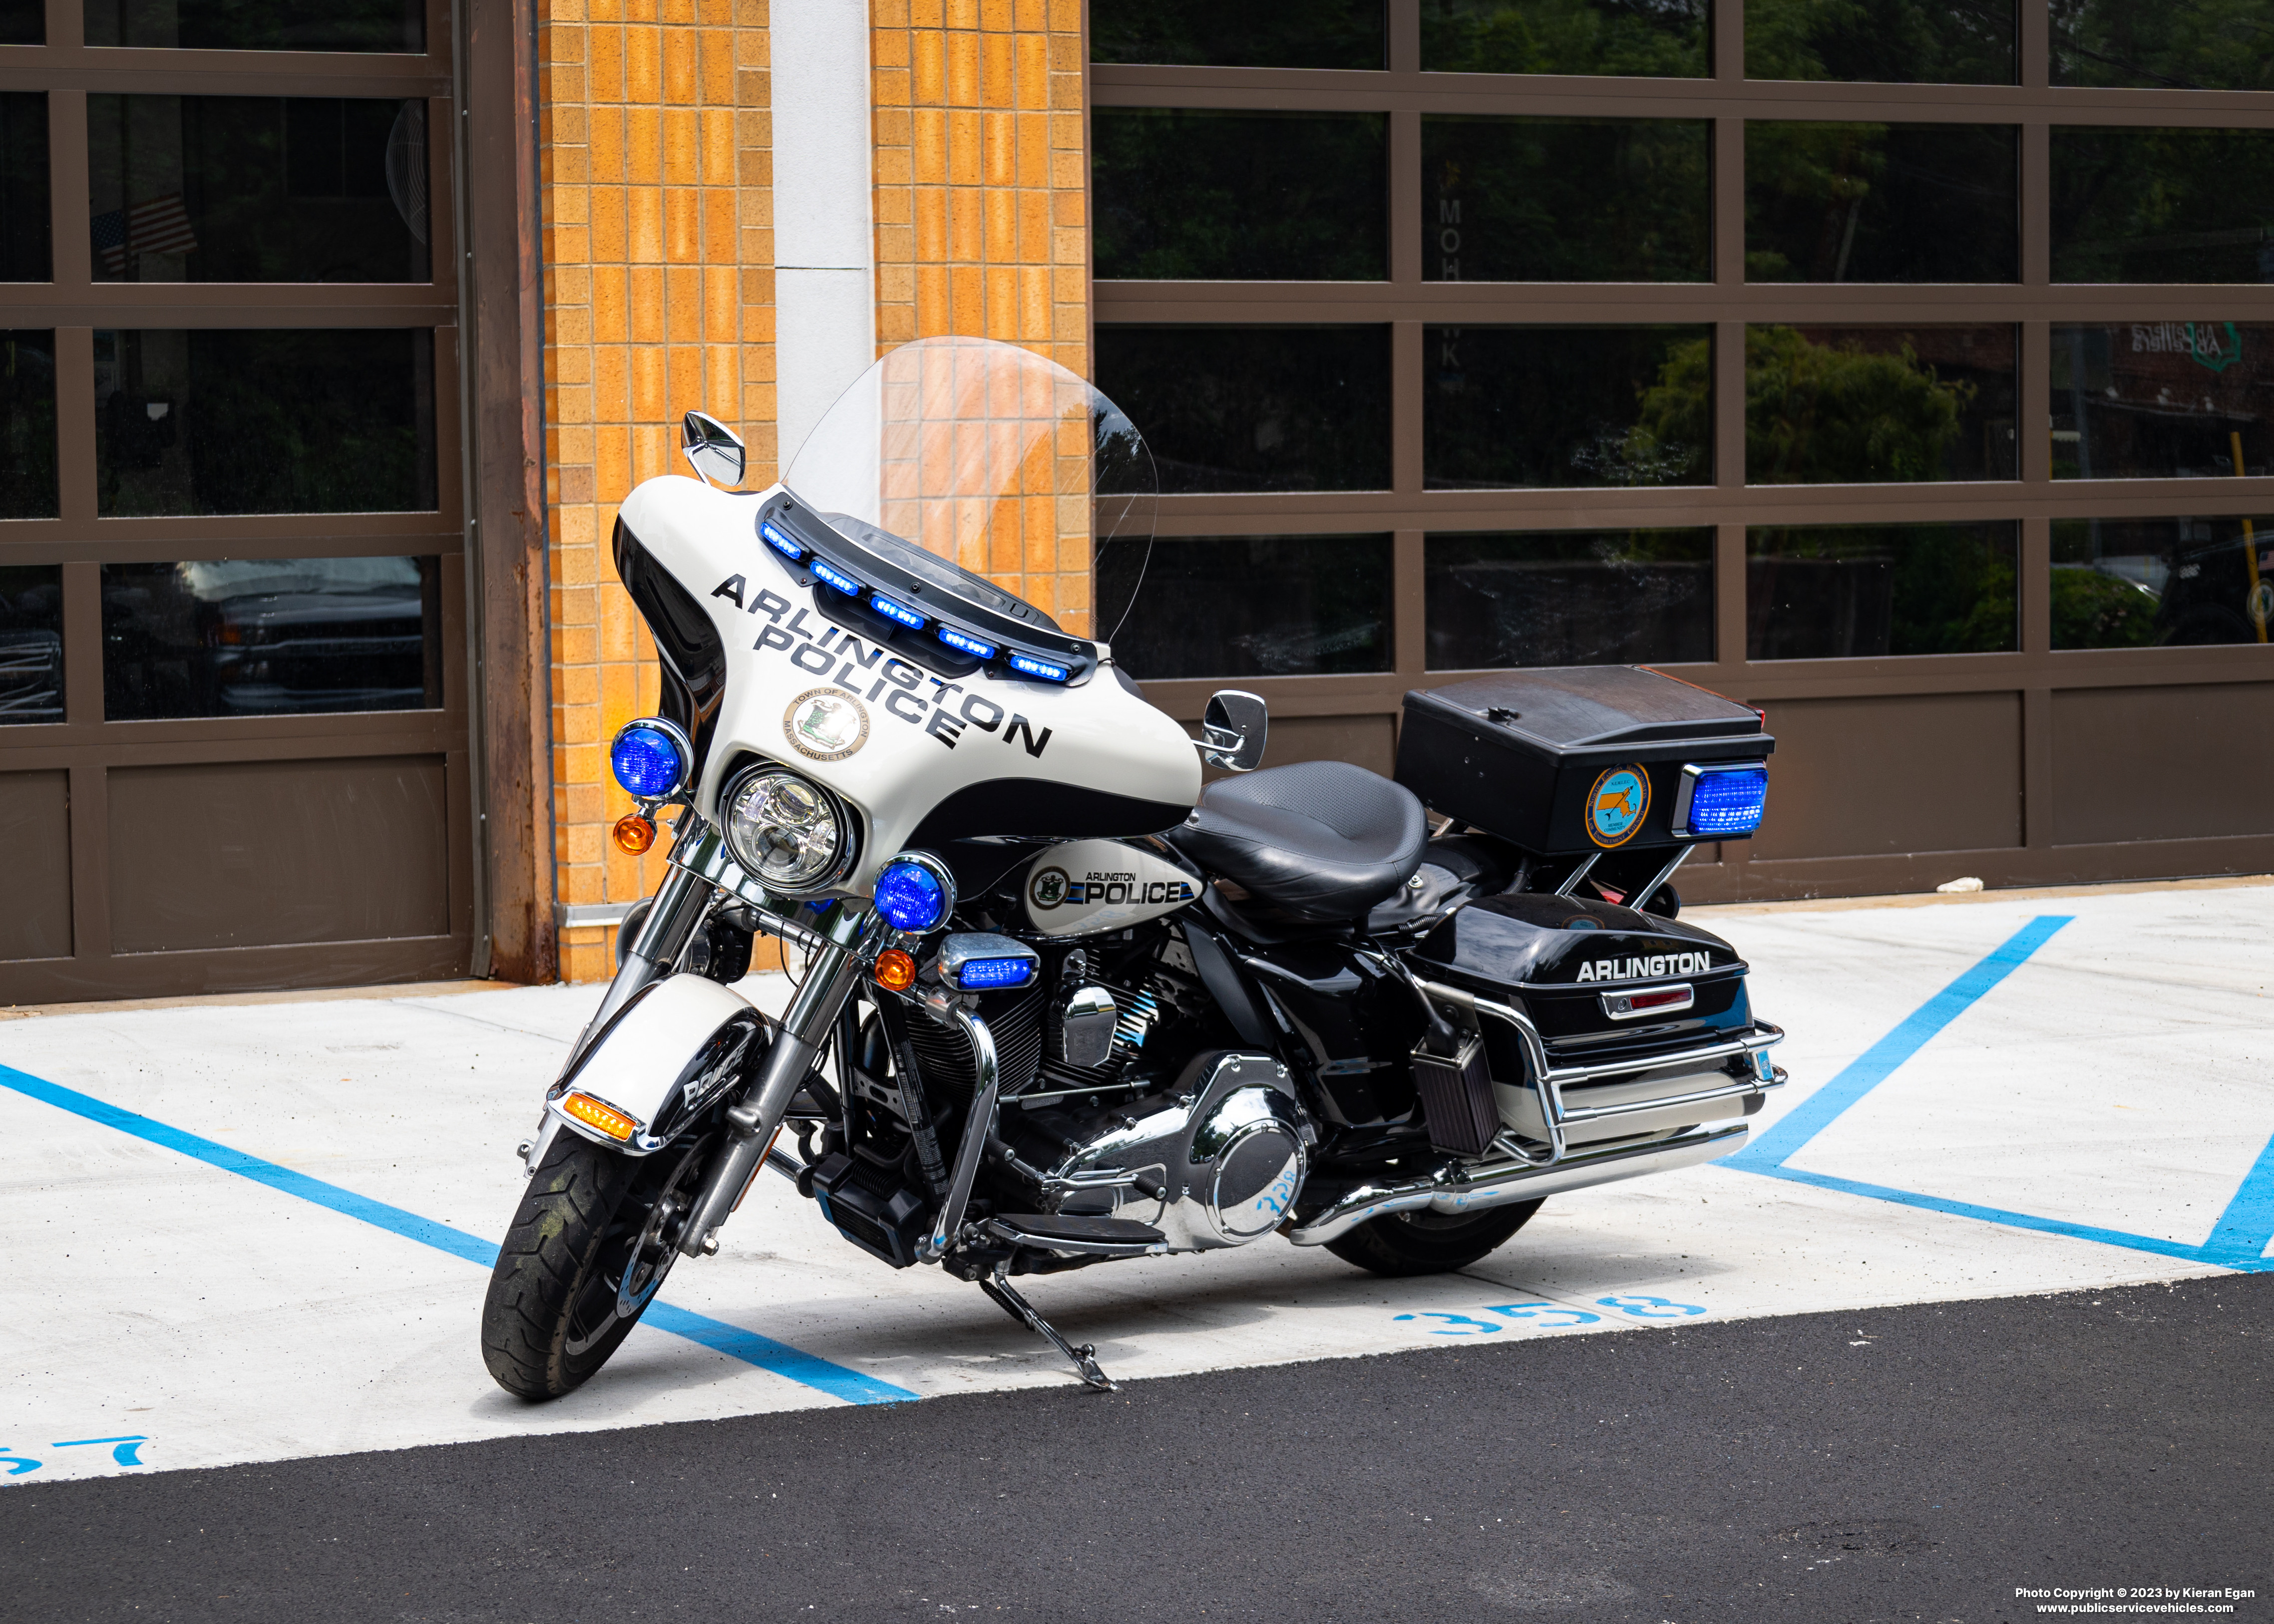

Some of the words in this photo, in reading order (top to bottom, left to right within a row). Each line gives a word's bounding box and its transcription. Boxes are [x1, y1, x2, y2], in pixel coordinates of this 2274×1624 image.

[1439, 199, 1461, 367] MOHK
[711, 573, 1053, 758] ARLINGTON
[753, 626, 971, 750] POLICE
[793, 689, 821, 705] TOWN
[839, 692, 869, 738] ARLINGTON
[784, 720, 853, 761] MASSACHUSETTS
[1588, 785, 1600, 807] NORTH
[1601, 766, 1623, 782] EASTERN
[1625, 764, 1647, 799] MASSACHUSETTS
[1593, 830, 1626, 844] ENFORCEMENT
[1627, 811, 1645, 834] COUNCIL
[1084, 881, 1180, 905] POLICE
[1085, 872, 1136, 882] ARLINGTON
[1576, 951, 1711, 982] ARLINGTON
[684, 1041, 749, 1108] POLICE
[1393, 1295, 1707, 1335] 358
